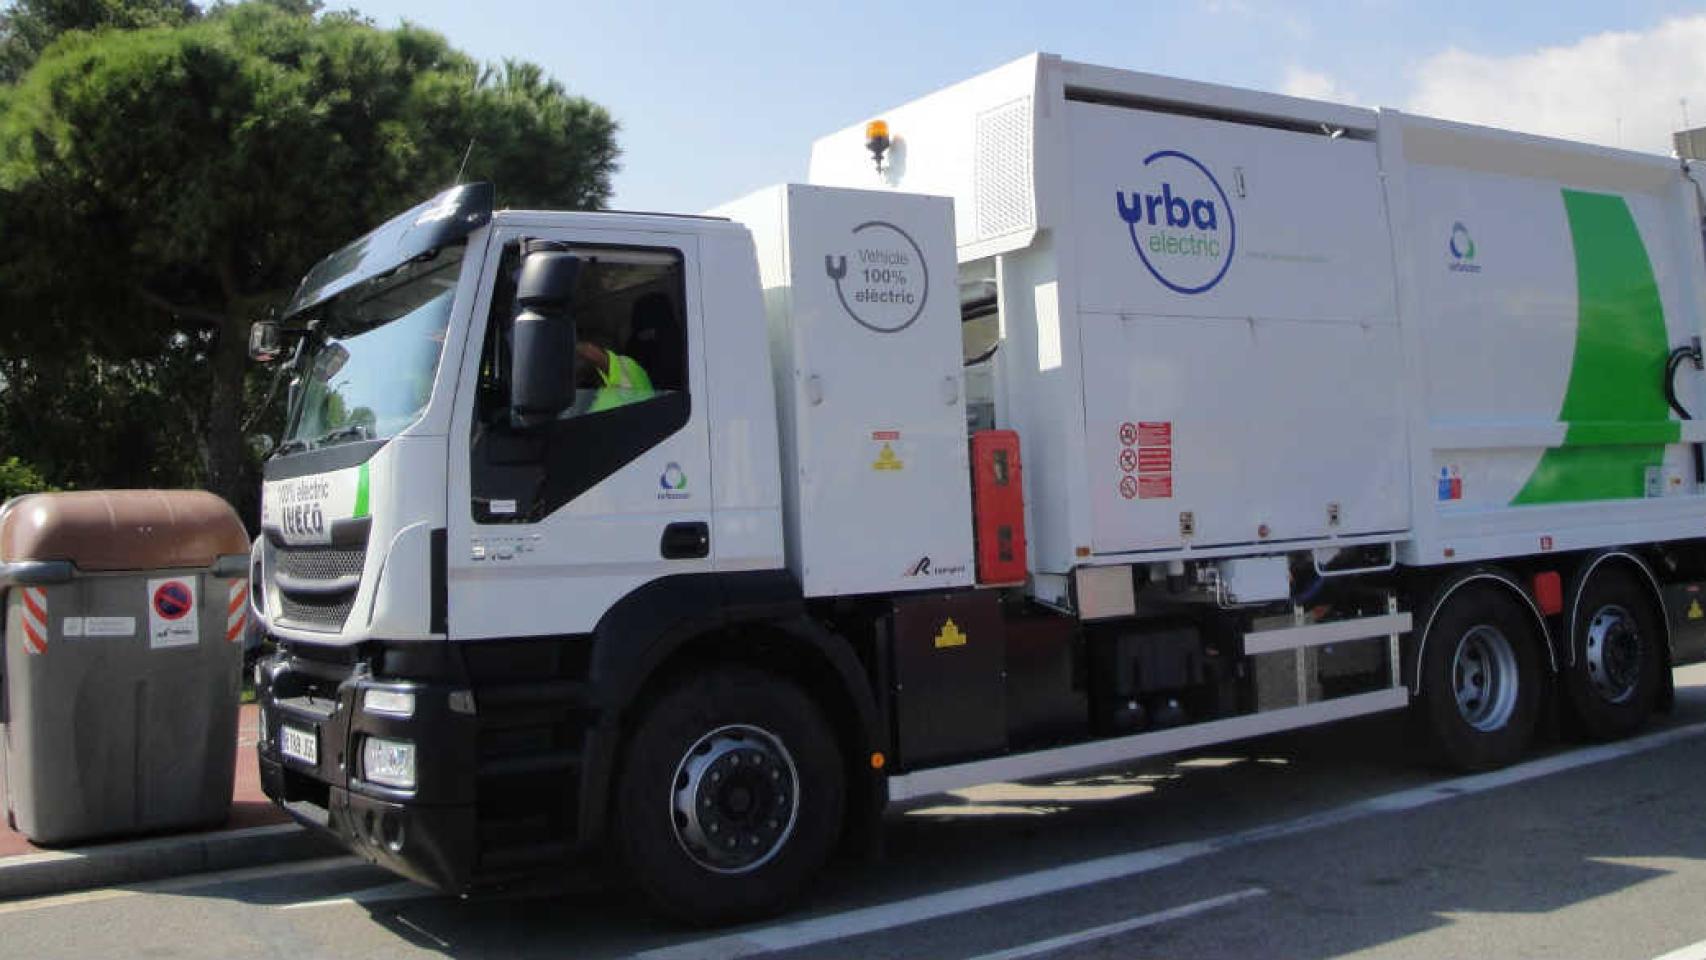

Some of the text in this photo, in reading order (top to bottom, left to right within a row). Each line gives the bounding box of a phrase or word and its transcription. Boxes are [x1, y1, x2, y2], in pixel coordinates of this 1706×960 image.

[1116, 183, 1218, 231] urba
[863, 268, 907, 285] 100%
[283, 502, 324, 535] IVECO
